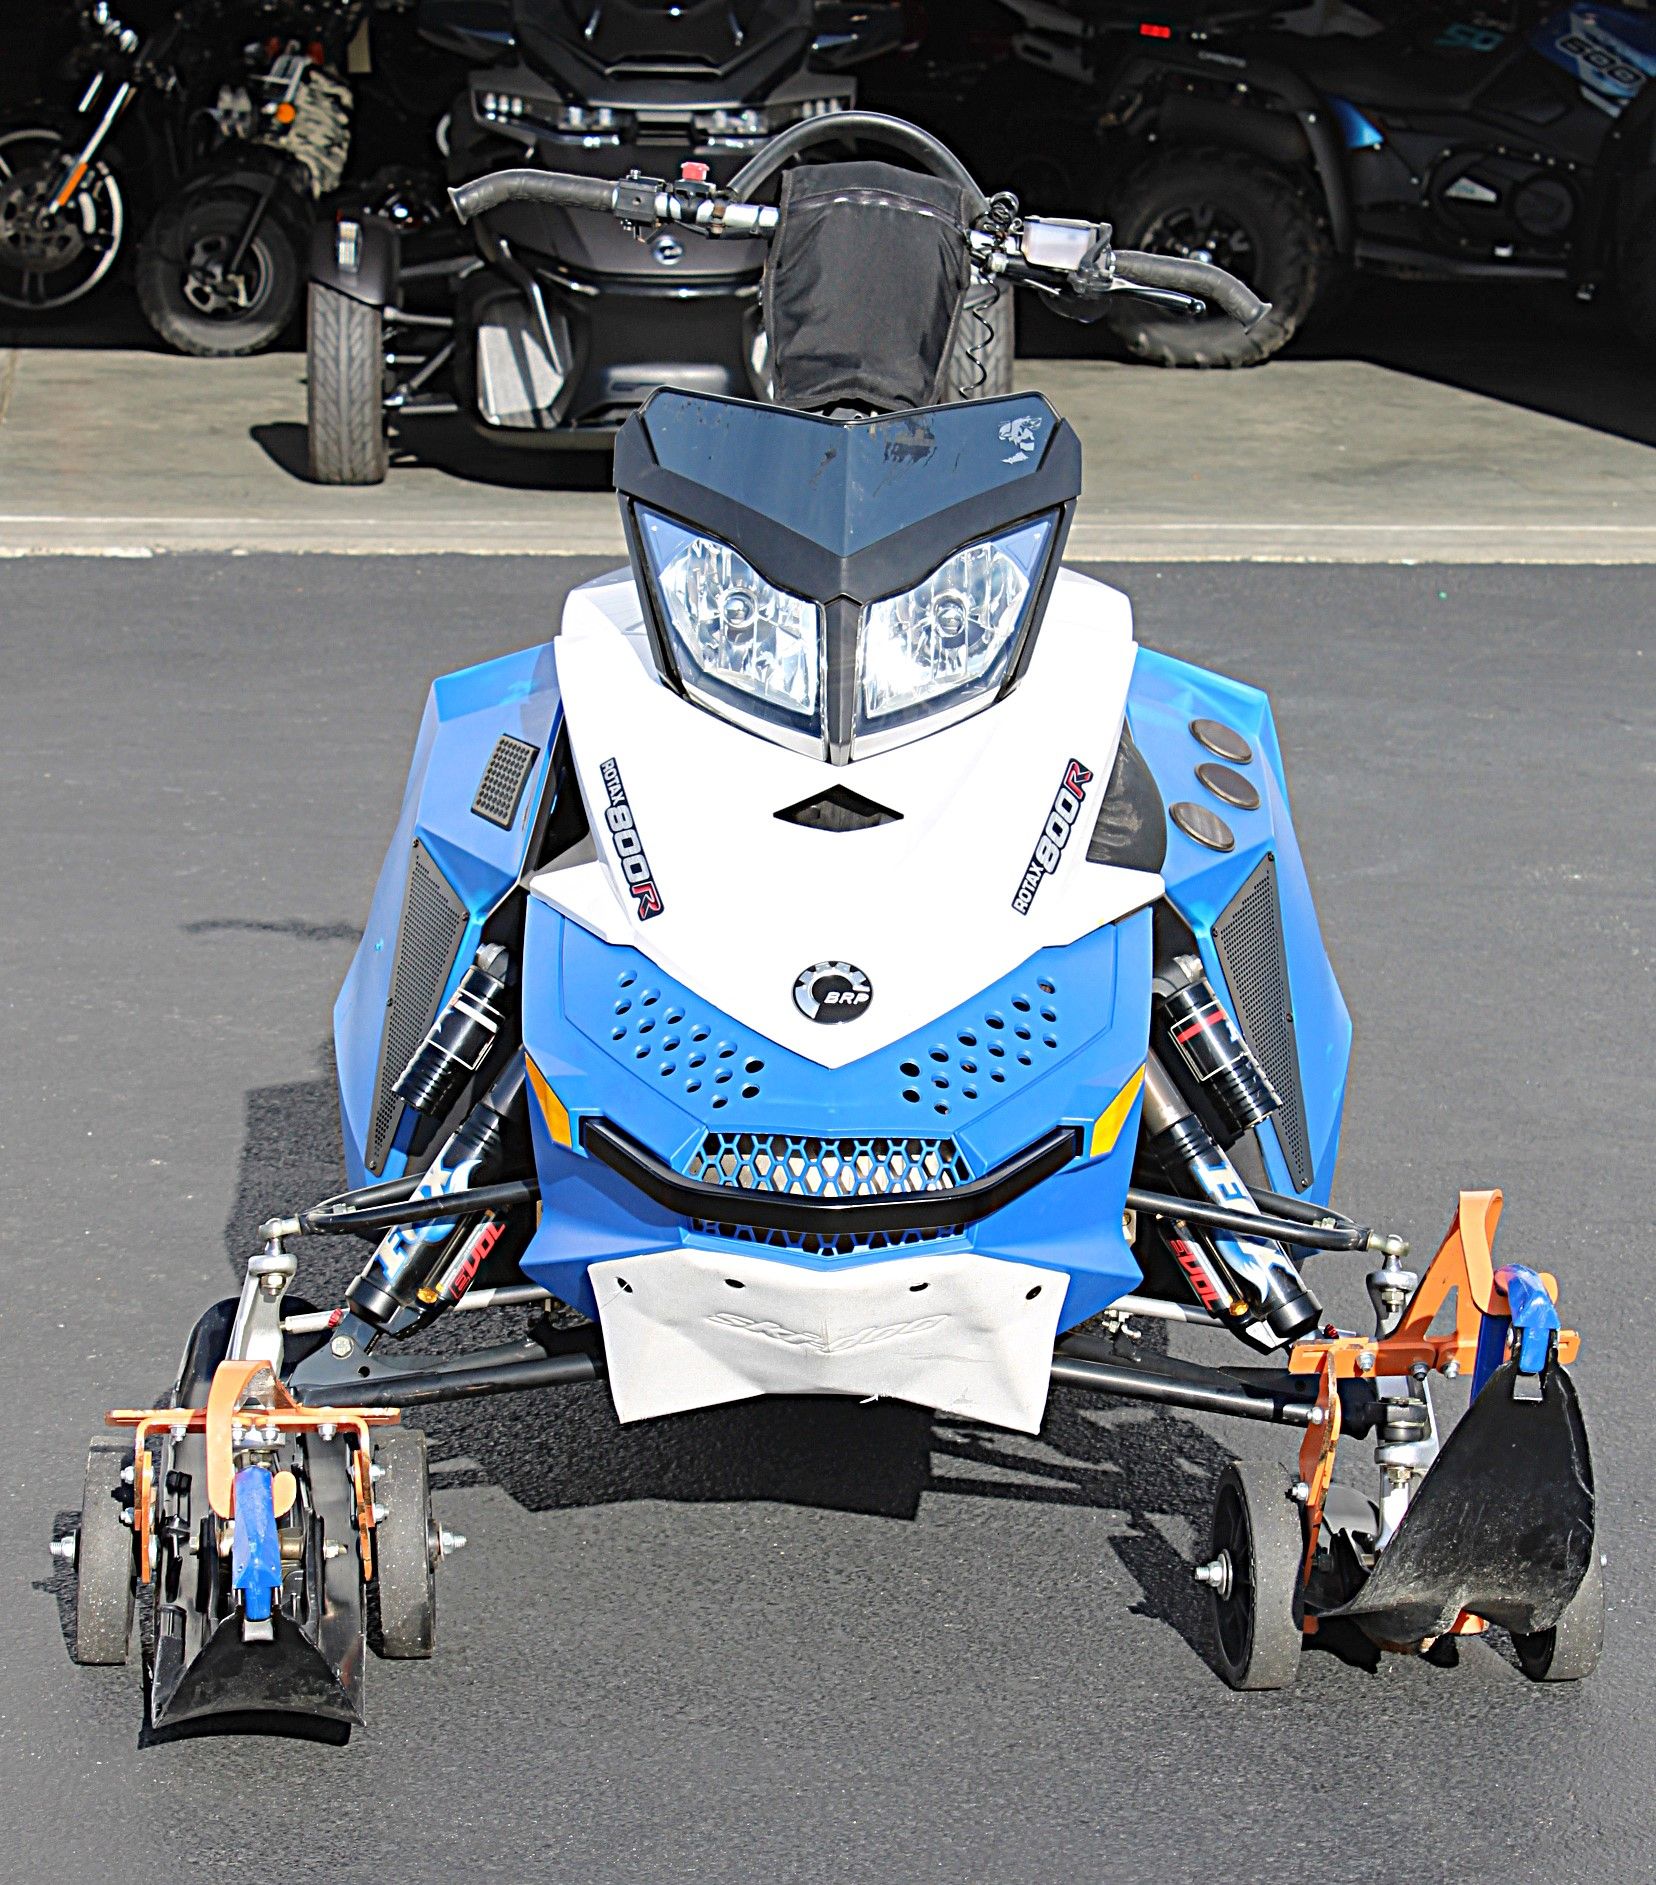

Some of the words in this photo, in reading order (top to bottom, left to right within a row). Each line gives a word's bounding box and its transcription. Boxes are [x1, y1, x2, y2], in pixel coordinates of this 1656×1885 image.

[601, 758, 626, 806] ROTAX
[606, 803, 663, 920] 800R
[1012, 861, 1044, 914] ROTAX
[1035, 760, 1093, 874] 800R
[823, 991, 870, 1005] BRP
[449, 1222, 506, 1299] EVOL
[1169, 1239, 1220, 1311] EVOL
